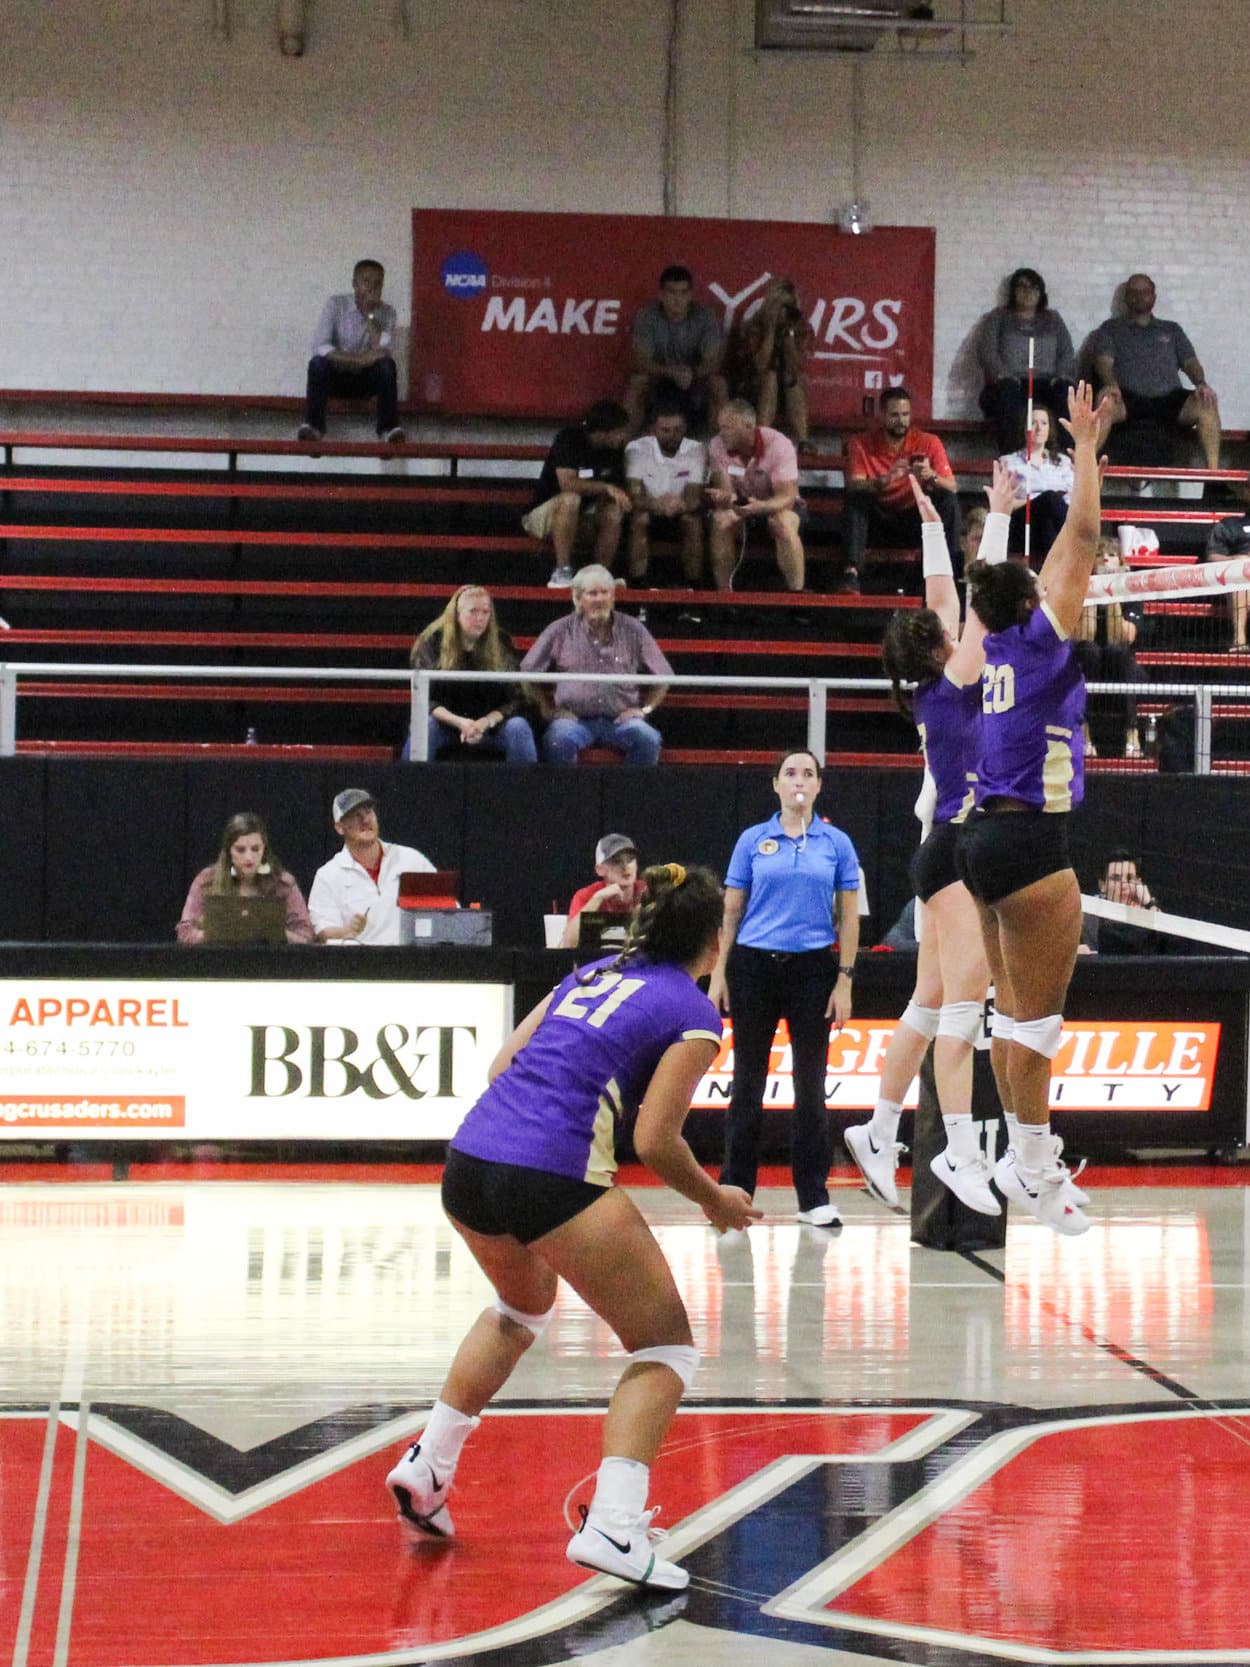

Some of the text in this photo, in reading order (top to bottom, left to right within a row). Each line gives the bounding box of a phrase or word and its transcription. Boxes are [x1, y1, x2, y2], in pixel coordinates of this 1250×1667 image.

[445, 274, 487, 287] NCAA
[491, 275, 541, 288] Division
[481, 296, 621, 335] MAKE
[708, 271, 902, 350] YRS
[983, 663, 1015, 714] 20
[9, 998, 189, 1027] APPAREL
[553, 970, 646, 1028] 21
[245, 1024, 477, 1100] BB&T
